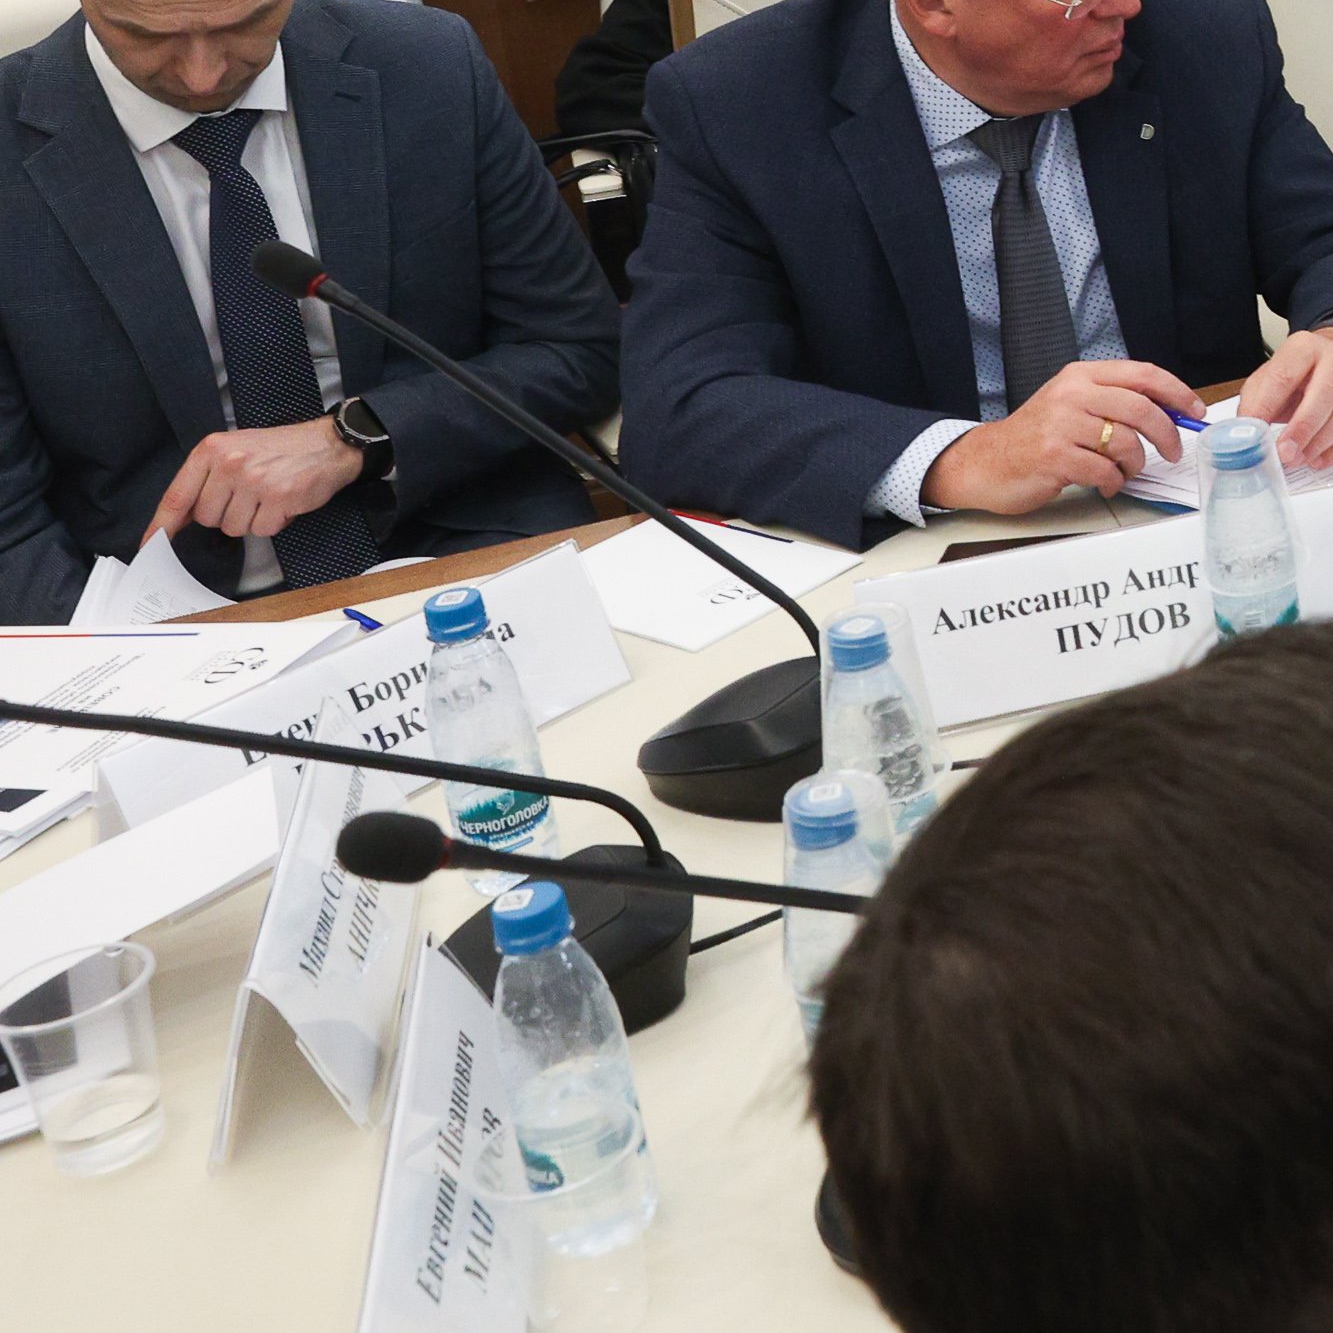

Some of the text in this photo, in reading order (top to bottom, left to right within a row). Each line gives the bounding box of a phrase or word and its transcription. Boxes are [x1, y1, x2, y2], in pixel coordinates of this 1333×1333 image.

[932, 561, 1199, 635] Александр Андр
[1054, 602, 1191, 654] ПУДОВ
[459, 794, 550, 835] ЧЕРНОГОЛОВКА
[415, 1029, 474, 1304] Евгений Иванович
